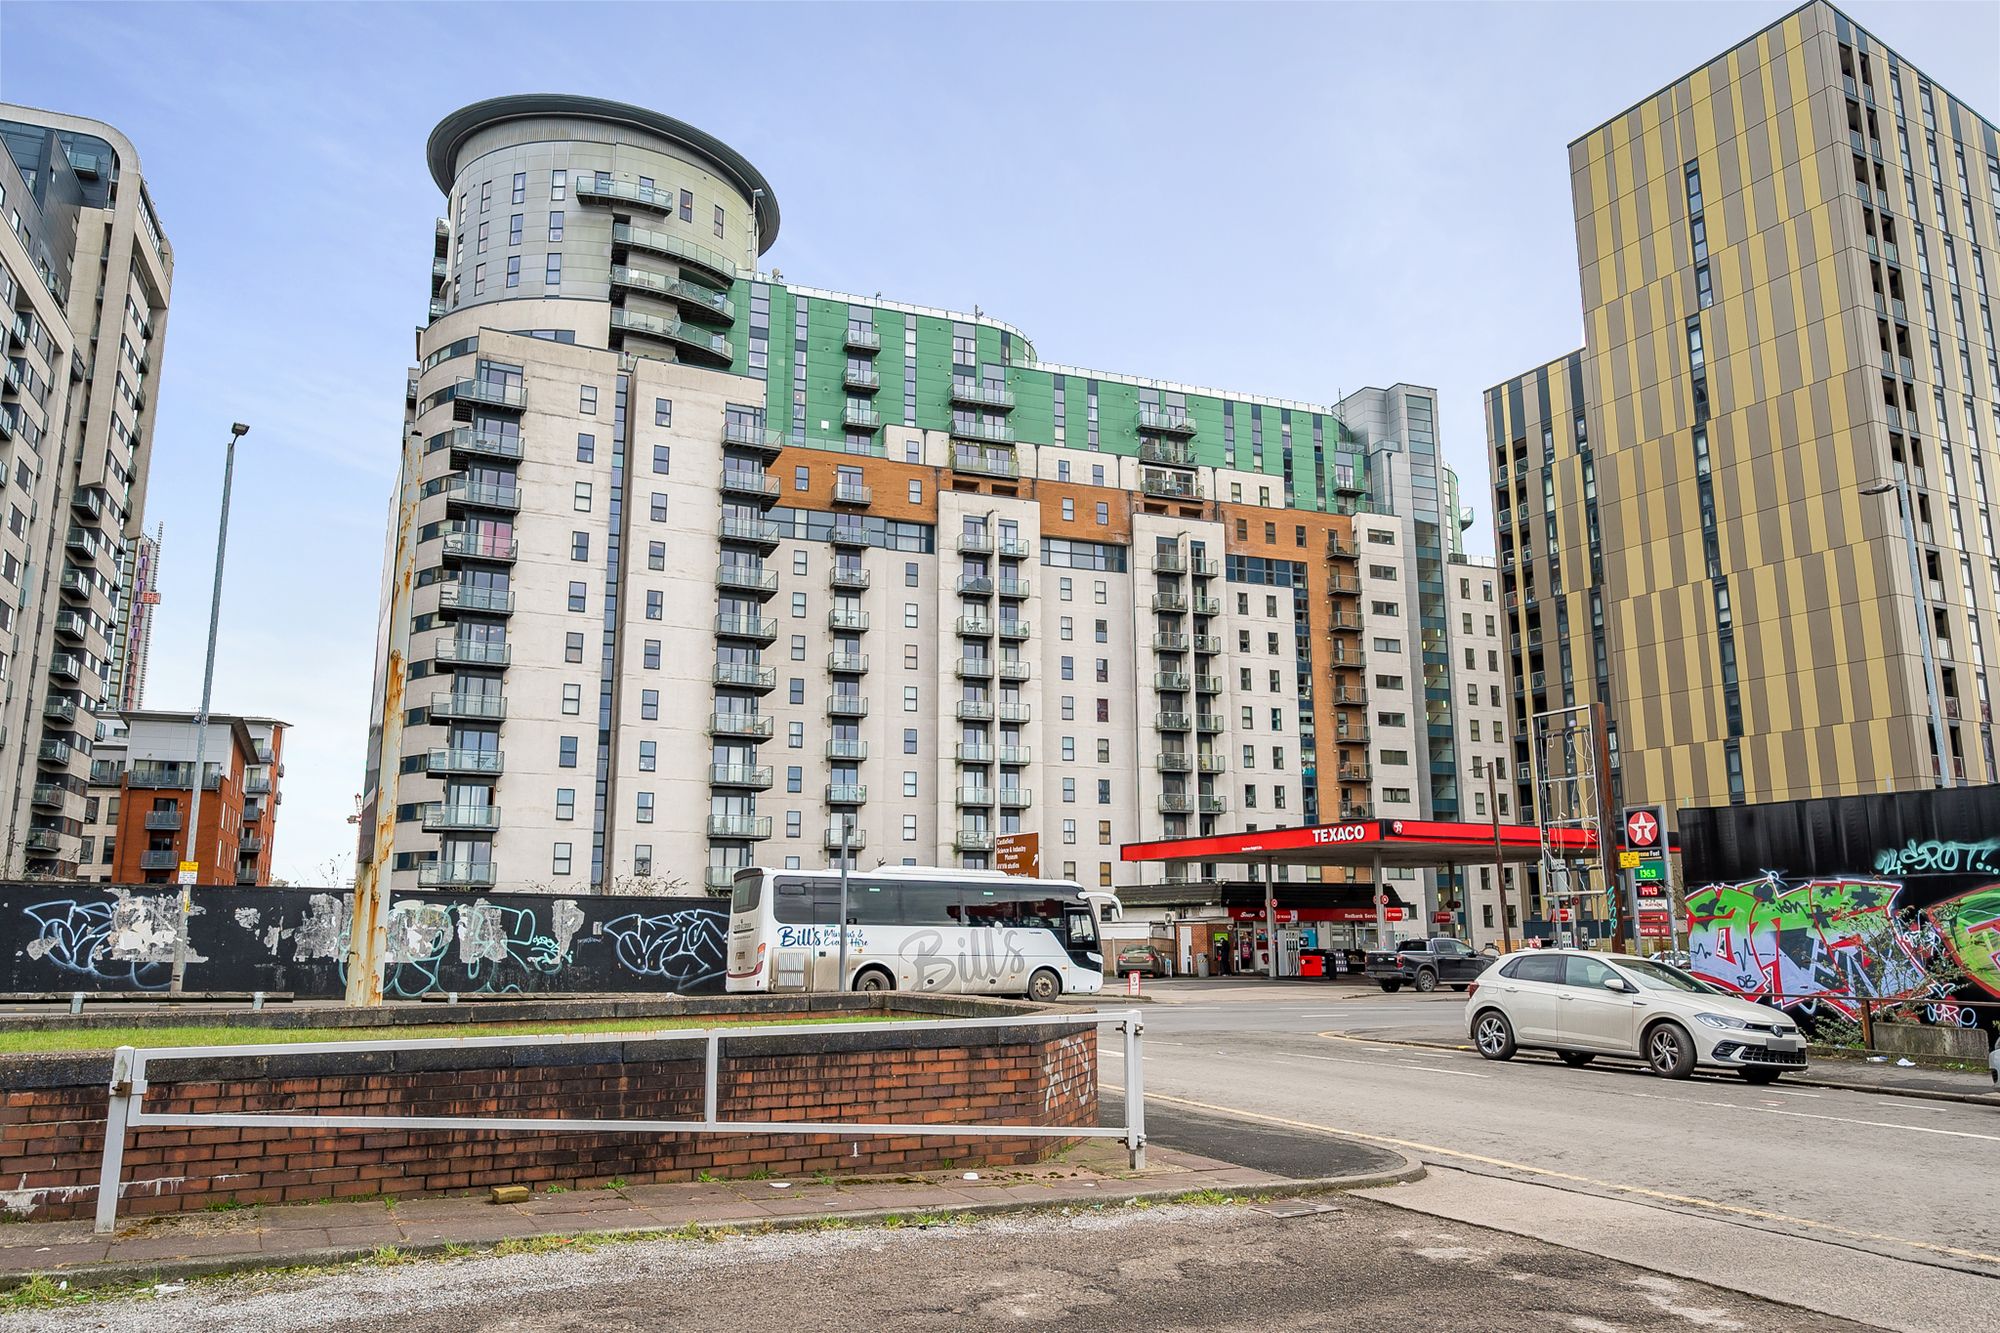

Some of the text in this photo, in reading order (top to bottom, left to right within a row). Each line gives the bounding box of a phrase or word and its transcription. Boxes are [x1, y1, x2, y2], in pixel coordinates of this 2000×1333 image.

[1312, 825, 1365, 843] TEXACO
[777, 926, 821, 947] Bill's
[898, 921, 1025, 992] Bill's
